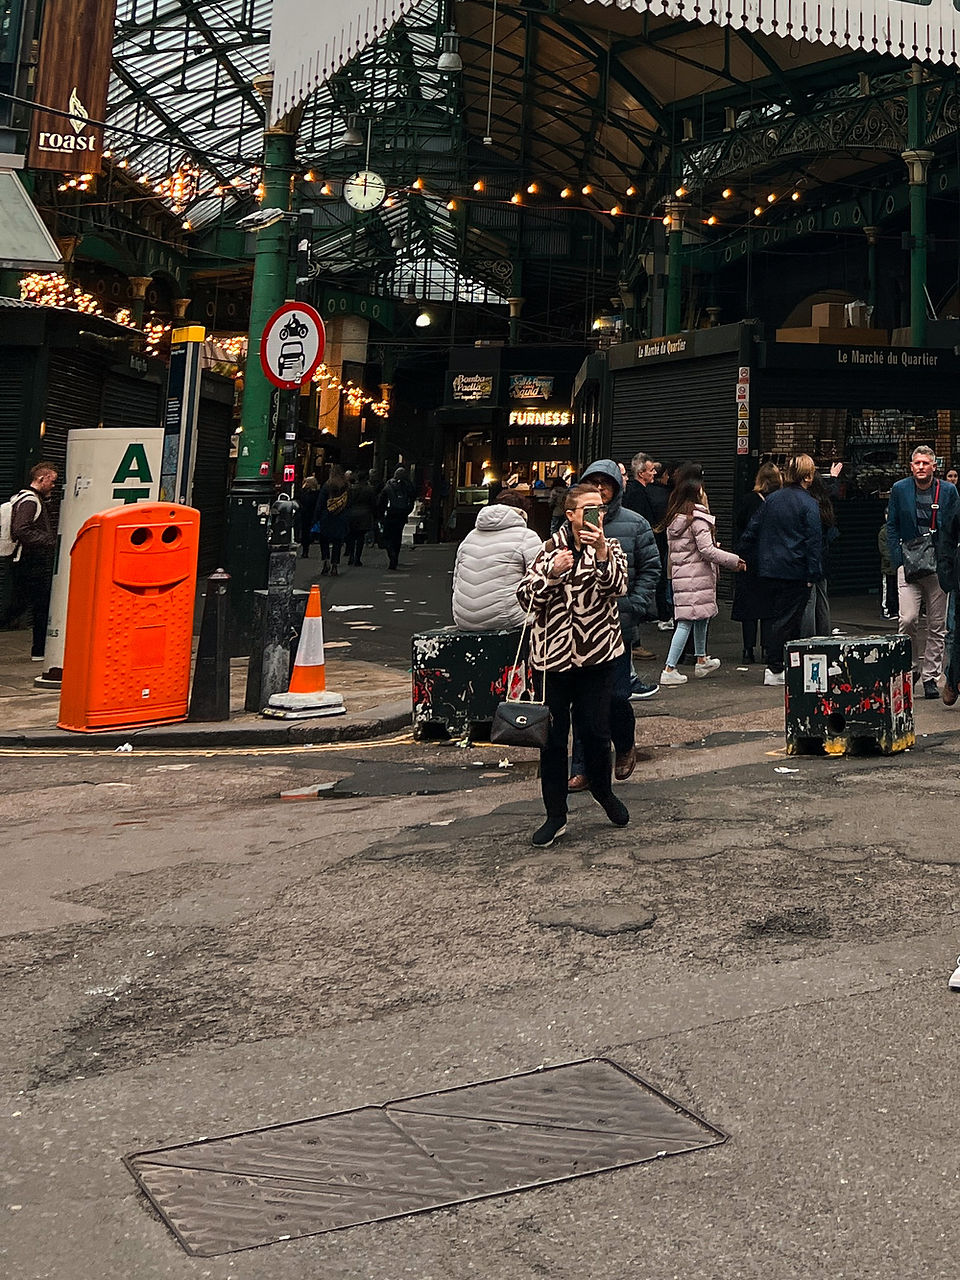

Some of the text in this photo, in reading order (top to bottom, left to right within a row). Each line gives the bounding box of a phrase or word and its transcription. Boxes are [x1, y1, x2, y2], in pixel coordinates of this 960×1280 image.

[38, 132, 97, 151] roast
[837, 349, 939, 368] Le Marché du Quartier
[457, 374, 486, 384] Bomba
[509, 411, 570, 426] FURNESS
